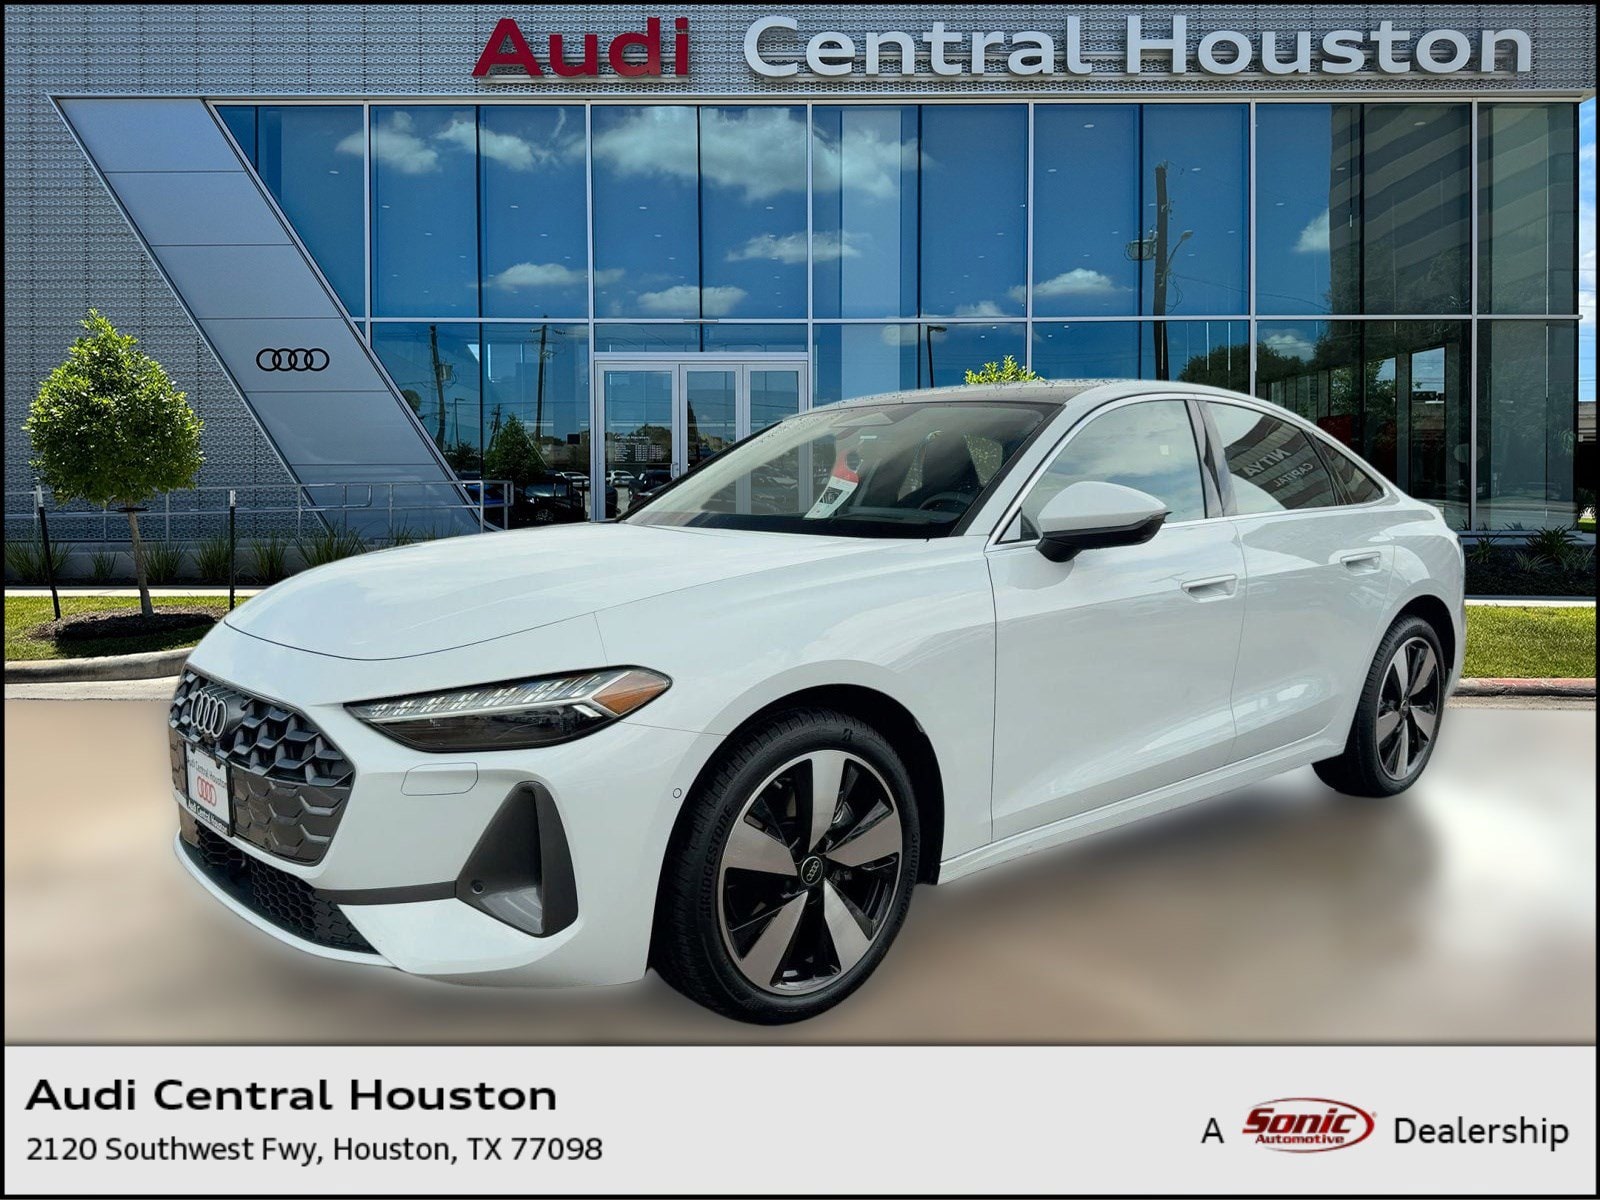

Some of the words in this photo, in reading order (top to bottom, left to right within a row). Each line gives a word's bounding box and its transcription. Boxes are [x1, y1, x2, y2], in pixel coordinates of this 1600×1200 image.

[472, 17, 689, 77] Audi
[743, 15, 1092, 76] Central
[1126, 15, 1532, 75] Houston
